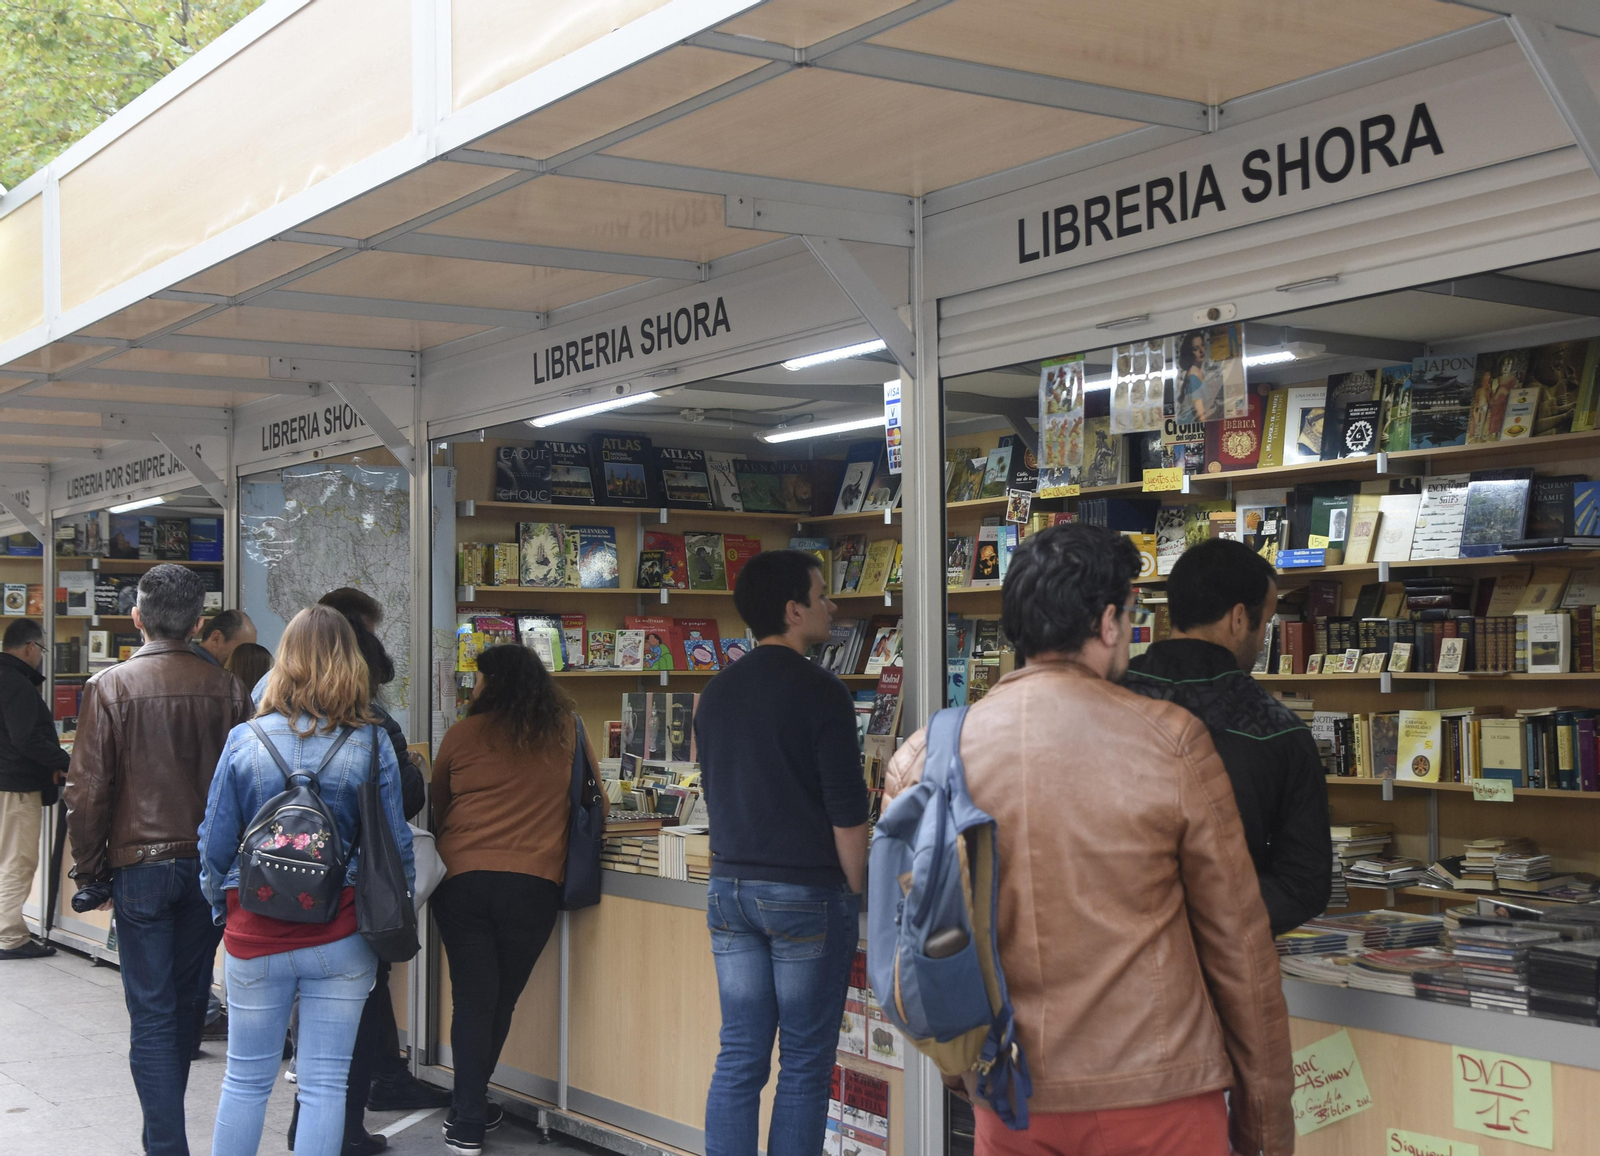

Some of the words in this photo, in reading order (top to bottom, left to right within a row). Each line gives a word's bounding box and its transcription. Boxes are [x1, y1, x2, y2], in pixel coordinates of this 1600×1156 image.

[1018, 163, 1226, 264] LIBRERIA
[1240, 102, 1444, 203] SHORA
[534, 325, 634, 385] LIBRERIA
[640, 296, 731, 355] SHORA
[1423, 357, 1475, 374] JAPON
[886, 387, 900, 398] VISA
[262, 412, 320, 451] LIBRERIA
[543, 442, 586, 455] ATLAS
[602, 438, 641, 452] ATLAS
[660, 448, 702, 460] ATLAS
[889, 453, 901, 463] JCB
[67, 471, 104, 500] LIBRERIA
[105, 466, 123, 490] POR
[125, 454, 165, 486] SIEMPRE
[499, 489, 548, 501] CHOUC
[1438, 495, 1459, 504] SHIPS
[1293, 1054, 1320, 1077] aac
[1456, 1053, 1531, 1090] DVD
[1294, 1060, 1355, 1094] Asimov
[1314, 1102, 1351, 1124] Biblia
